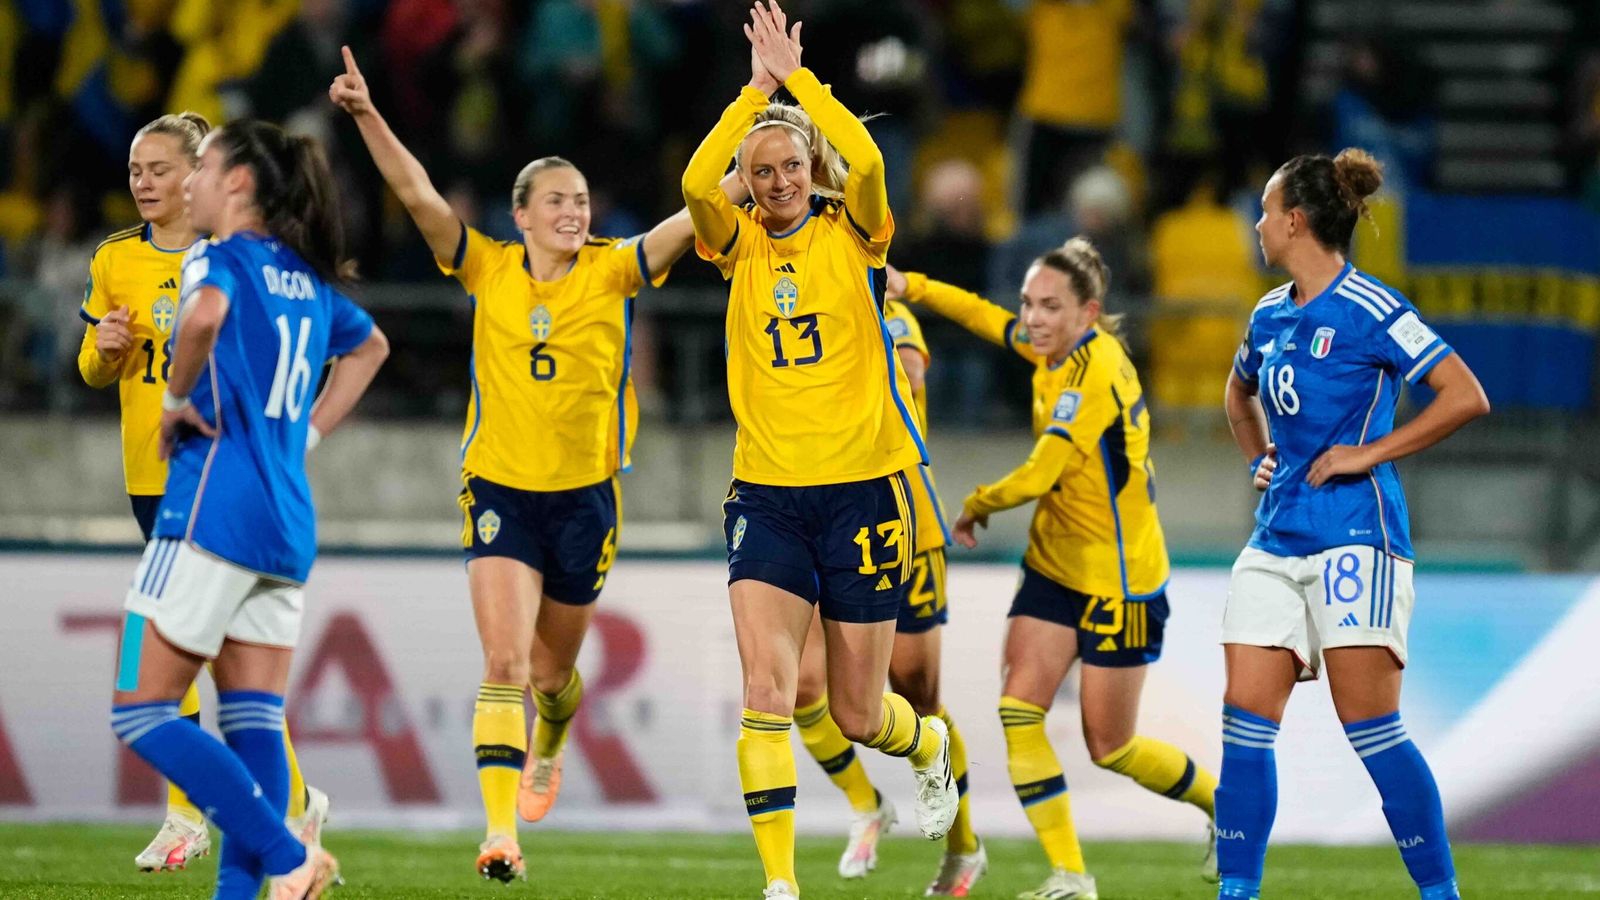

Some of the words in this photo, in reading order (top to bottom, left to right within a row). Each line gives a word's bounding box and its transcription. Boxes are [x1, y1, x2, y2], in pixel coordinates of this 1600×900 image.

[530, 342, 556, 381] 6
[764, 313, 823, 368] 13
[264, 313, 313, 423] 16
[1268, 364, 1300, 416] 18
[596, 527, 616, 573] 6
[853, 519, 904, 575] 13
[1323, 552, 1364, 606] 18
[1080, 596, 1124, 635] 23
